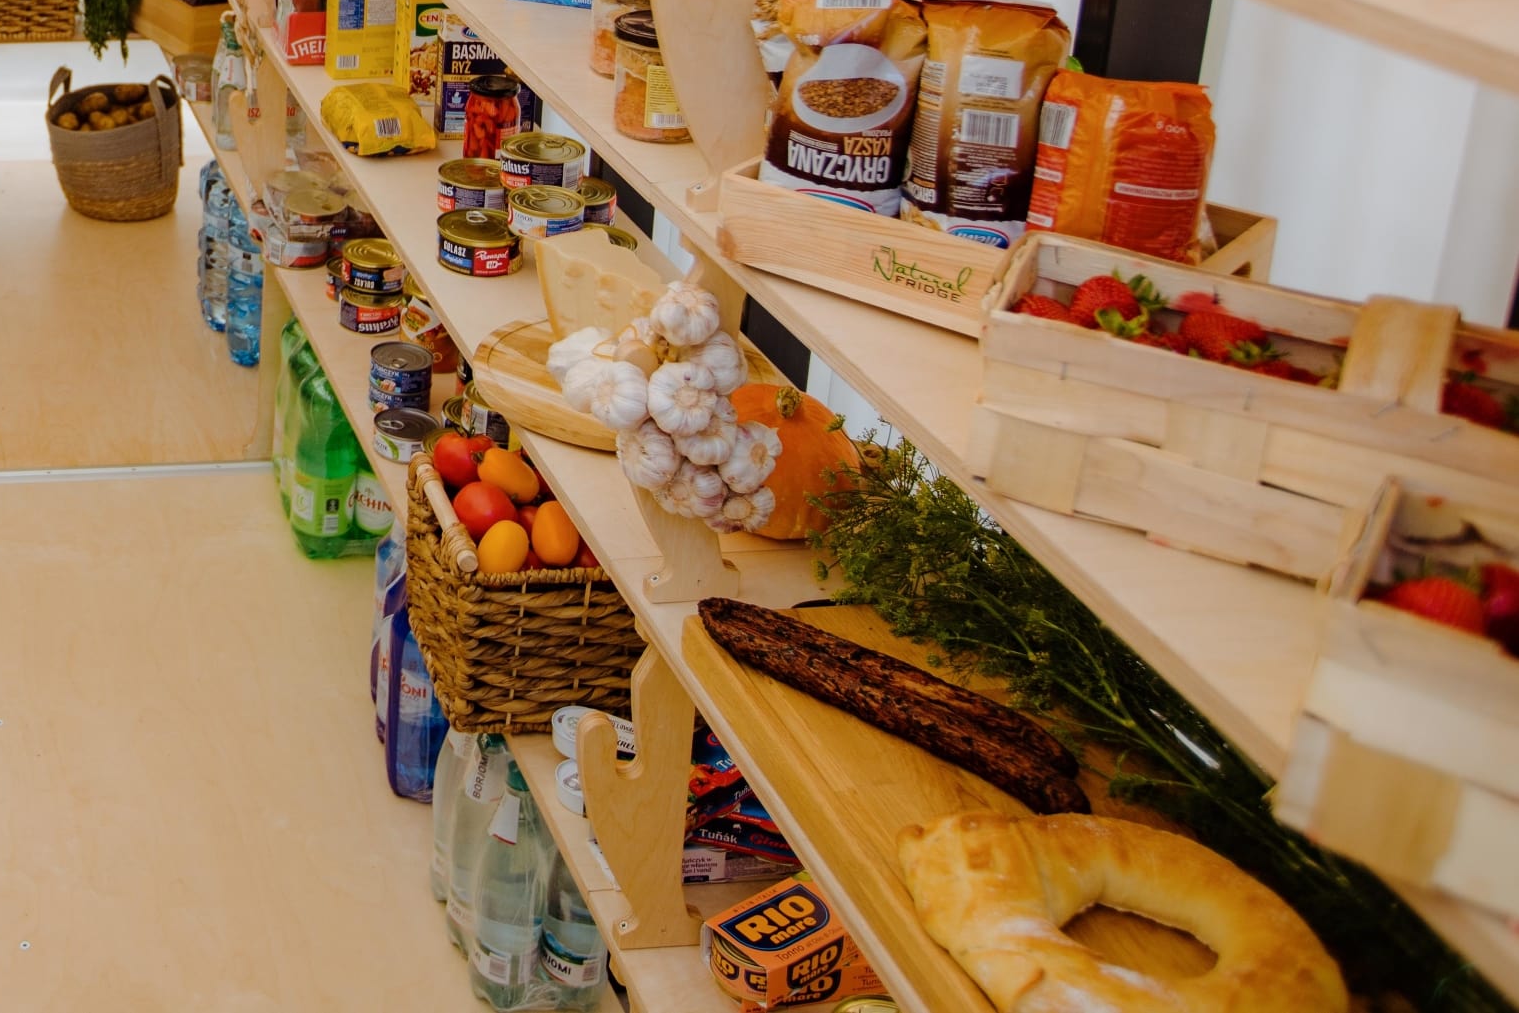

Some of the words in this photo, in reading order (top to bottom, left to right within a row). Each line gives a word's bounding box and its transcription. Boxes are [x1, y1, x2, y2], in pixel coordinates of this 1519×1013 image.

[297, 39, 327, 57] HEI
[451, 59, 472, 75] RYŻ
[843, 136, 892, 156] KASZA
[500, 159, 530, 175] rakus
[787, 139, 892, 184] GRYCZANA
[873, 249, 972, 296] Natural
[894, 275, 962, 304] FRIDGE
[735, 894, 816, 943] RIO
[769, 916, 818, 945] mare
[775, 944, 805, 962] Tonno
[792, 945, 838, 981] RIO
[799, 963, 829, 985] mare
